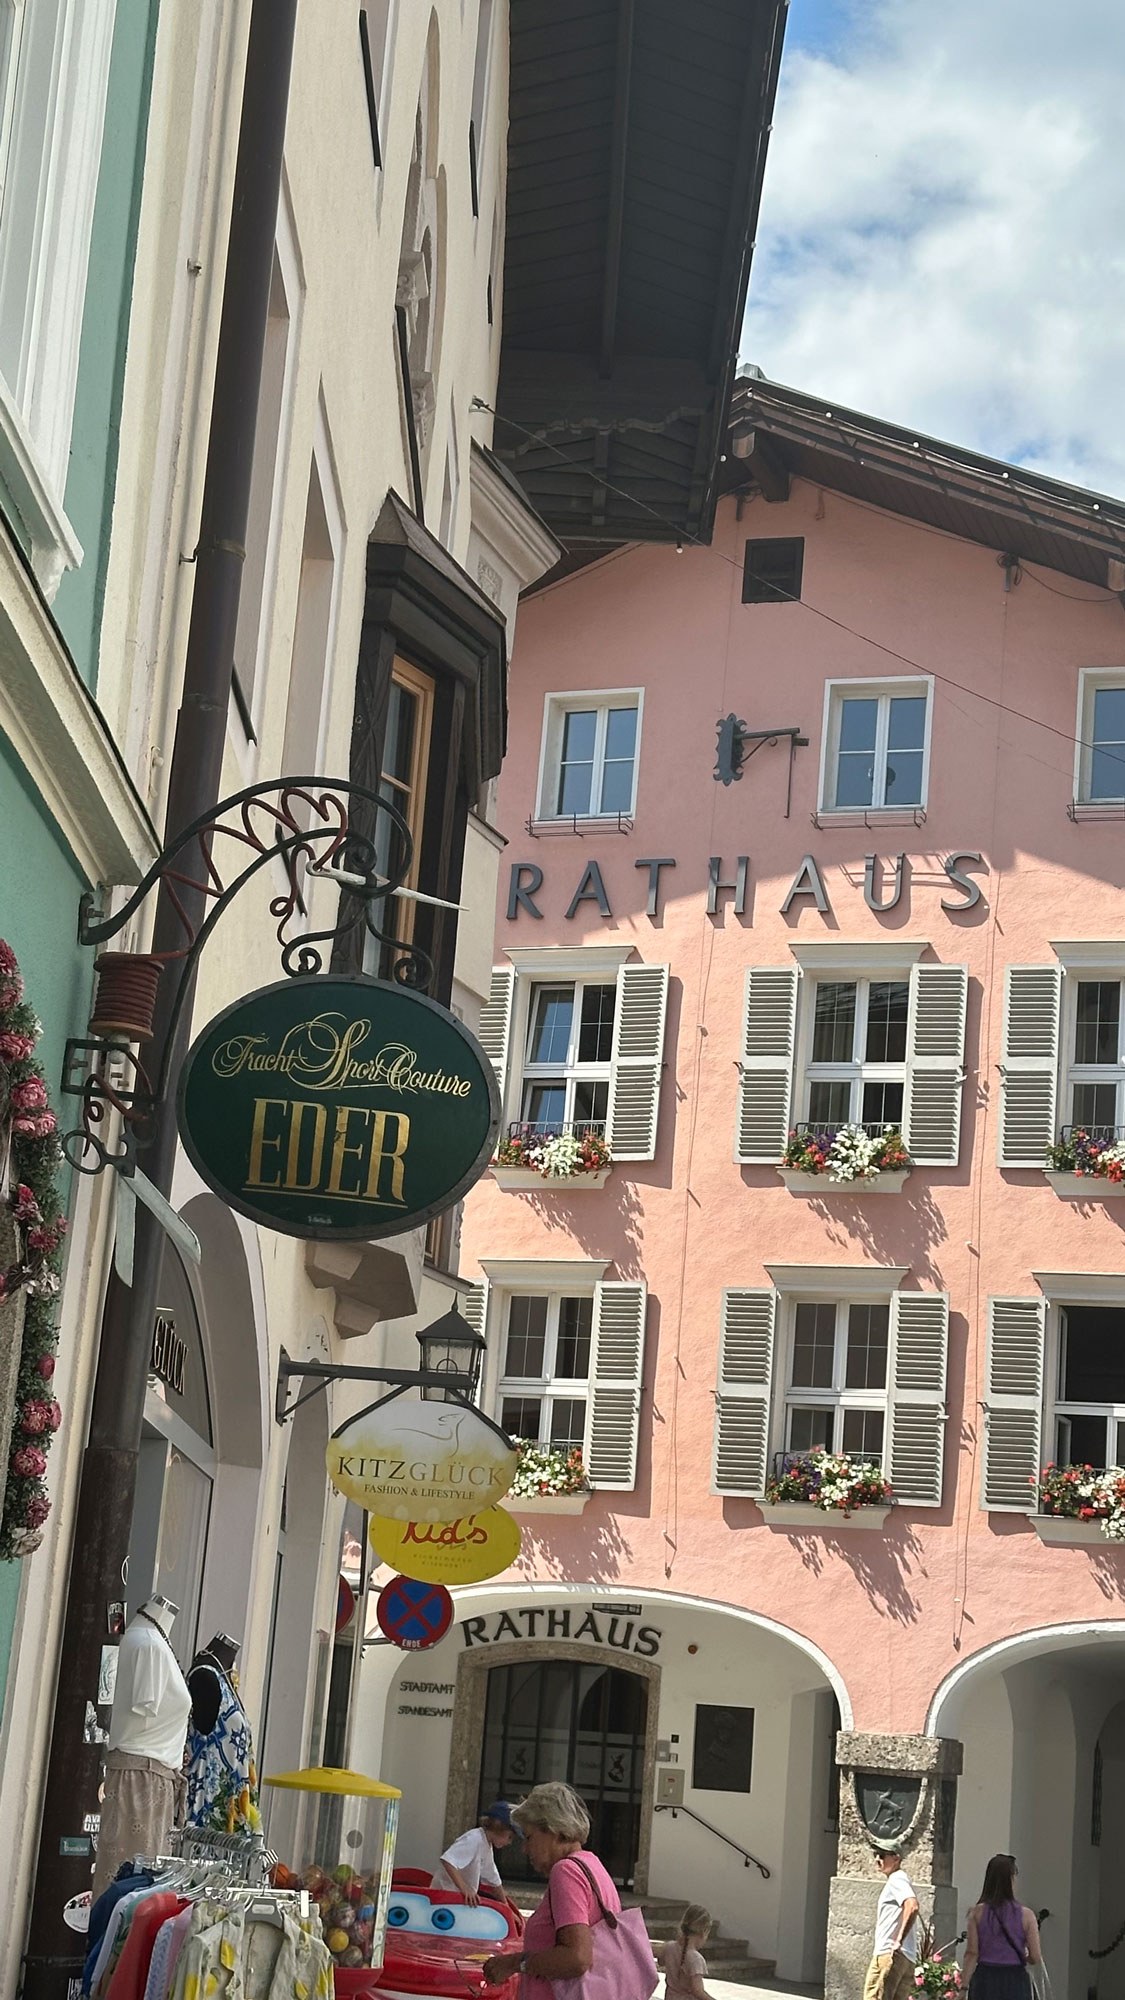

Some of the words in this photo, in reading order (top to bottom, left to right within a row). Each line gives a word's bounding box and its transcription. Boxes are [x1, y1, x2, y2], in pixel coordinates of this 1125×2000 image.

[506, 851, 984, 920] RATHAUS
[211, 1033, 308, 1078] Tracht
[285, 1012, 385, 1090] Sport
[375, 1043, 472, 1098] Couture
[244, 1098, 411, 1202] EDER
[337, 1456, 505, 1486] KITZGLÜCK
[364, 1484, 408, 1496] FASHION
[410, 1488, 418, 1497] &
[420, 1488, 475, 1500] LIFESTYLE
[402, 1639, 421, 1647] ENDE
[461, 1609, 662, 1657] RATHAUS
[400, 1681, 456, 1694] STADTAMT
[397, 1705, 454, 1718] STANDESAMT
